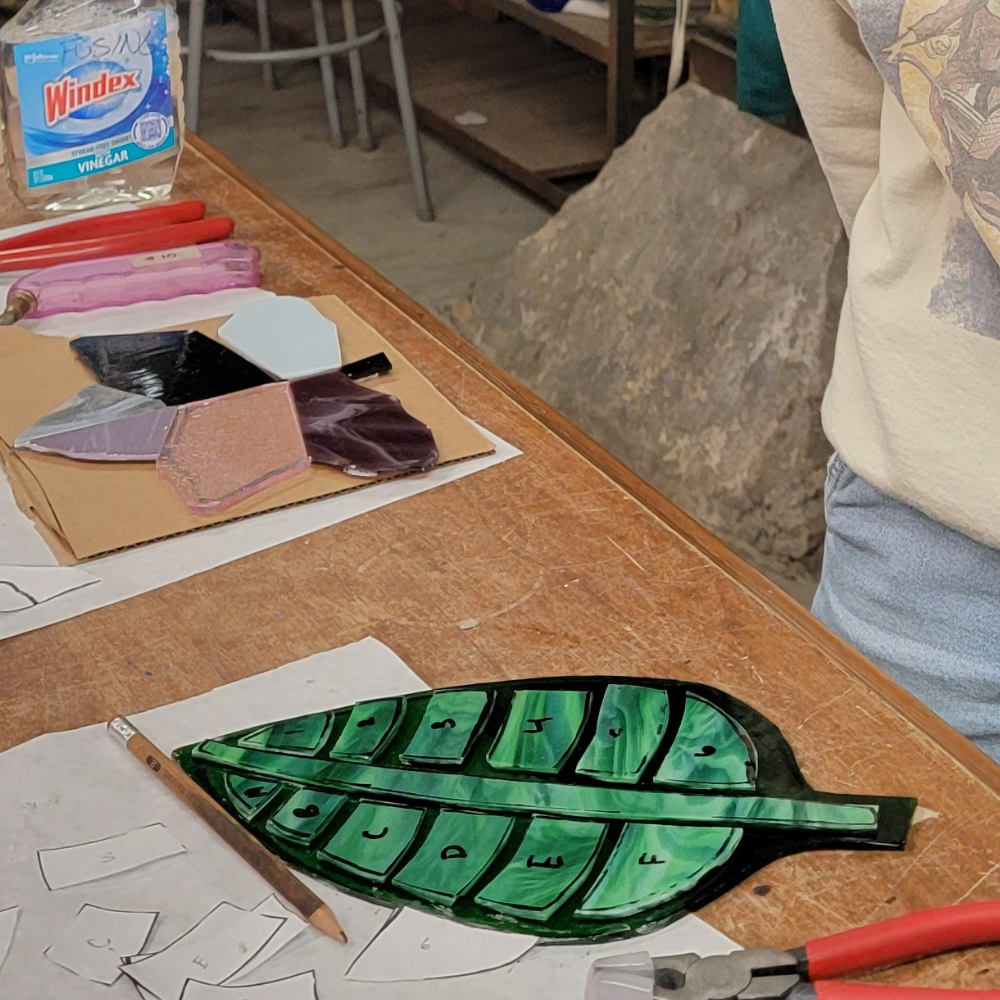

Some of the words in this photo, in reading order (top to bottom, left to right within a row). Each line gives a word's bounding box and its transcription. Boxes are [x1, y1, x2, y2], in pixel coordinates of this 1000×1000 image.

[44, 71, 140, 123] Windex
[78, 150, 128, 173] VINEGAR
[523, 717, 554, 733] 4
[440, 845, 468, 860] D
[638, 852, 666, 865] F
[526, 855, 564, 869] E
[420, 937, 431, 950] 6
[192, 954, 209, 970] E
